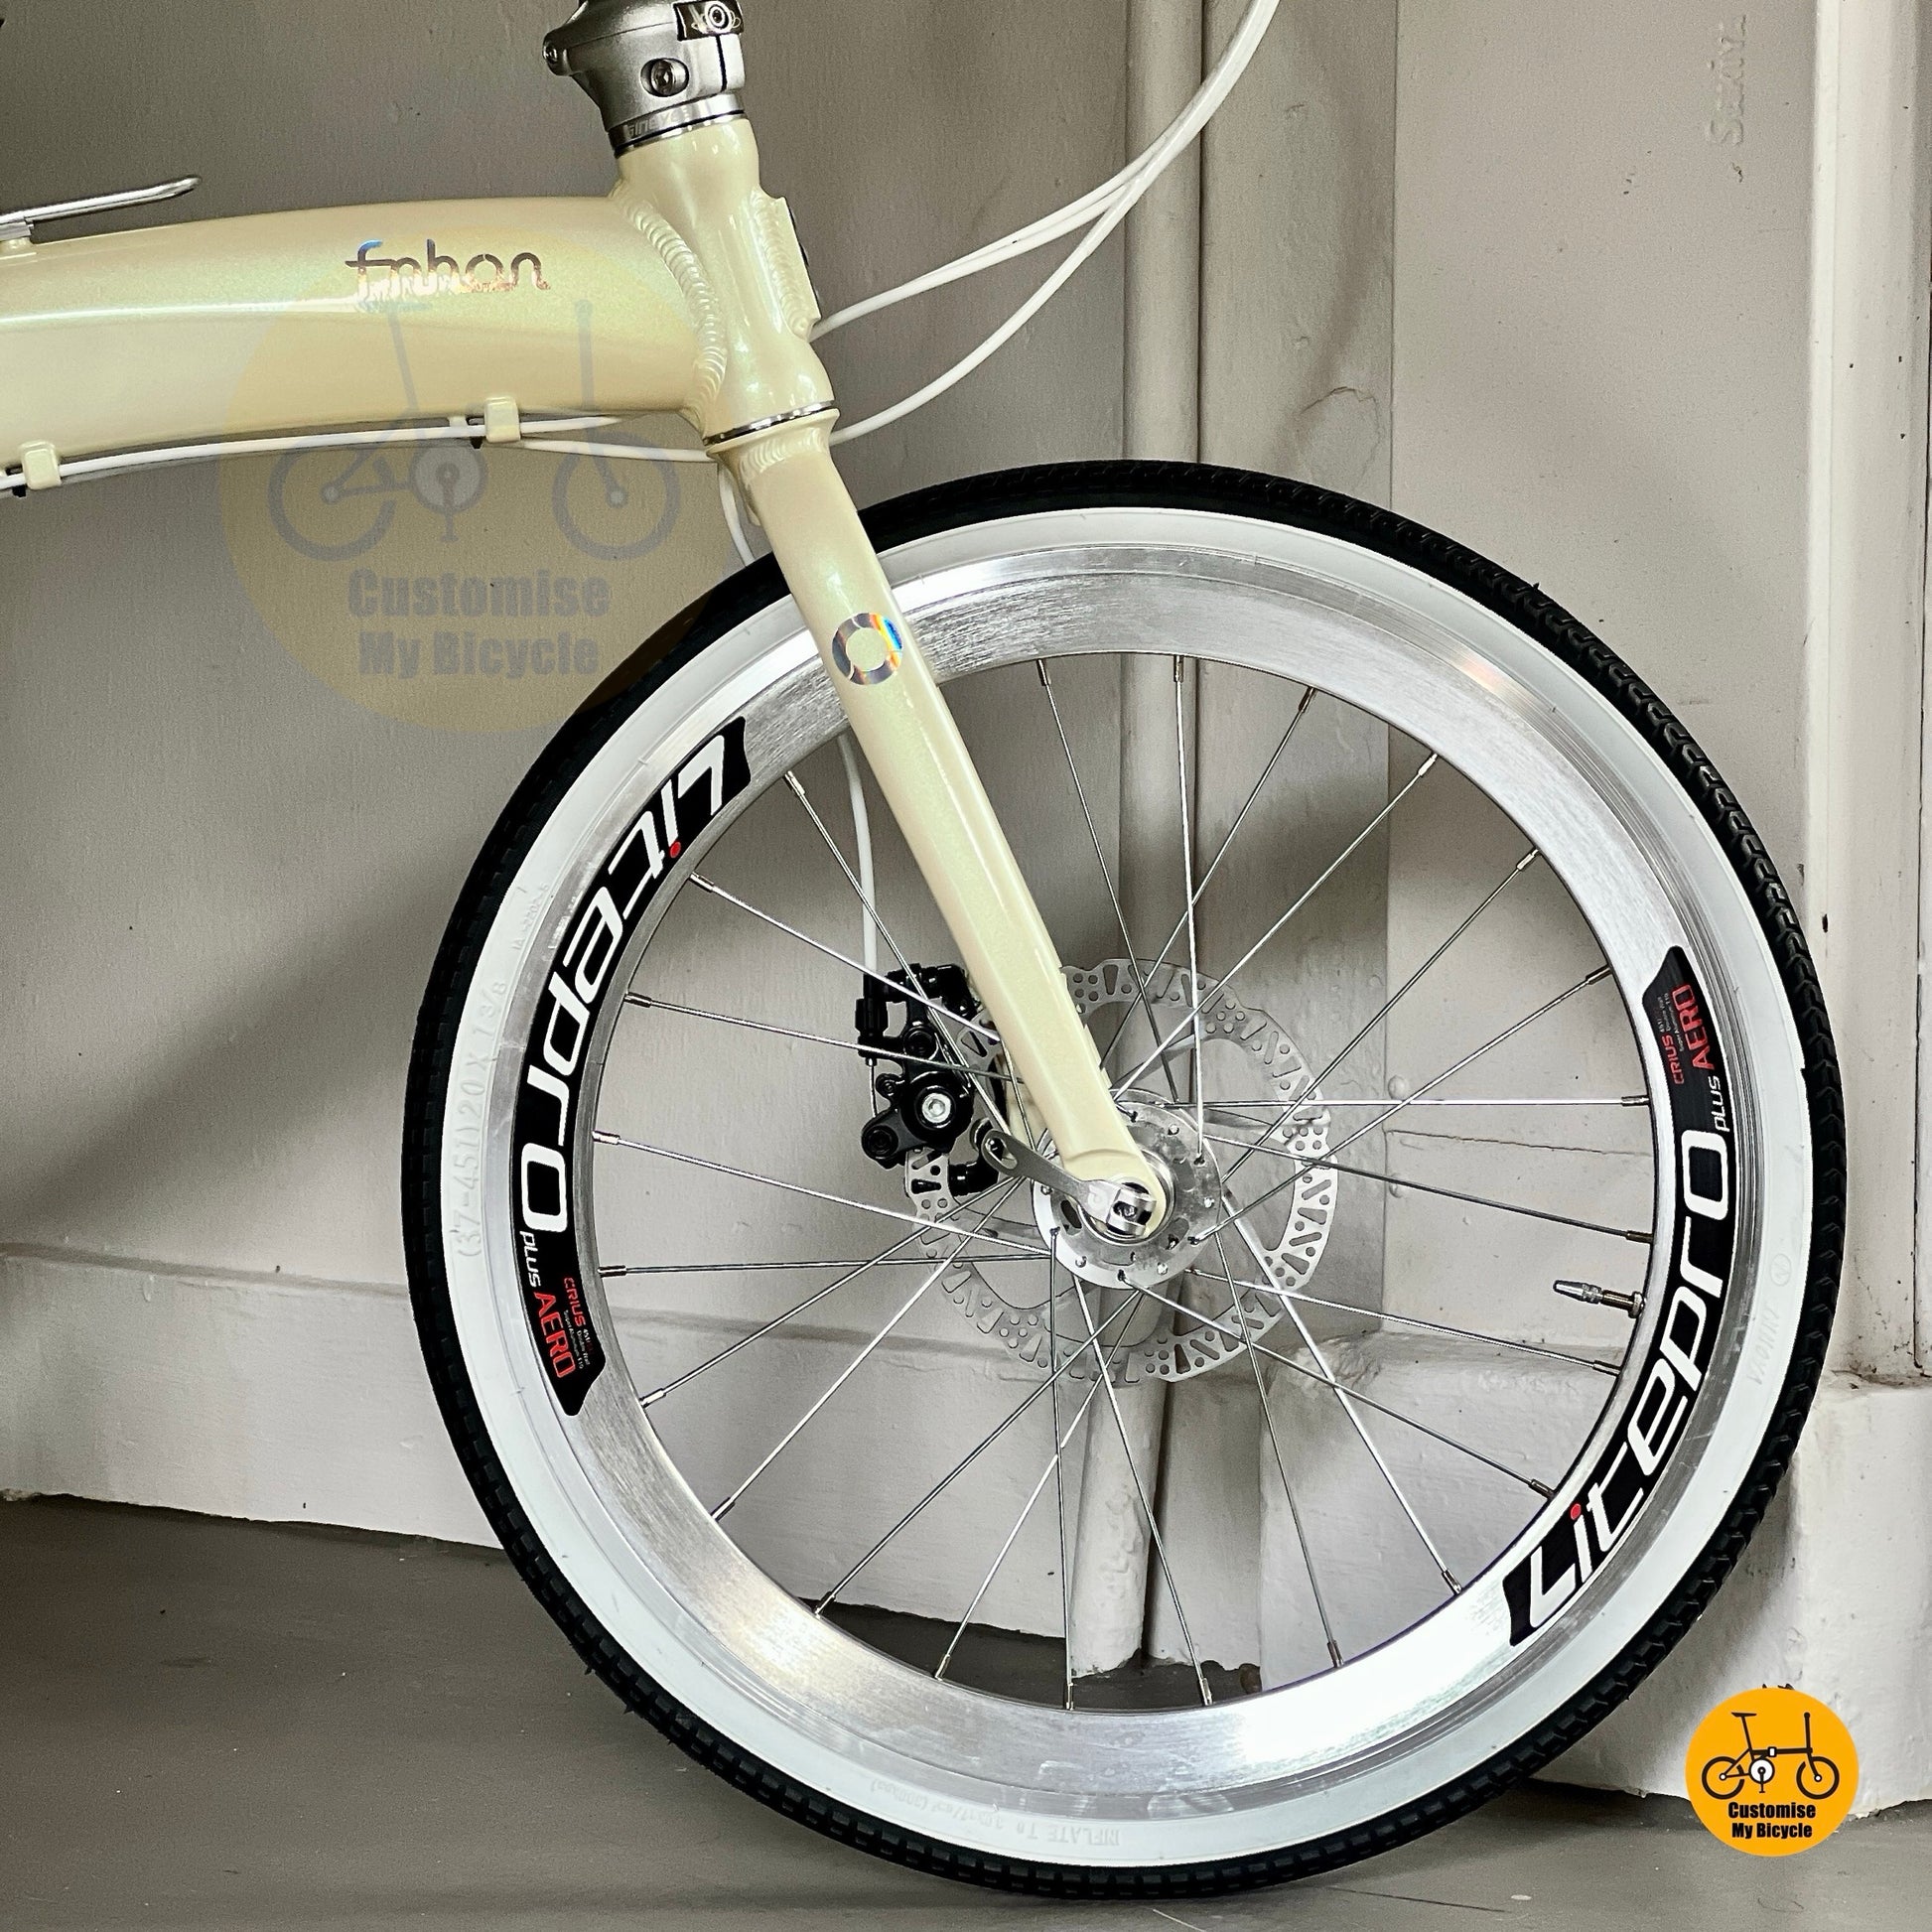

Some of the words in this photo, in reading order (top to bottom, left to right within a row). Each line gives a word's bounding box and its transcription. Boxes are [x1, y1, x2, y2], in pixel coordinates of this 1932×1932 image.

[521, 735, 725, 1232] Litepro
[1662, 1034, 1685, 1085] CRIUS
[534, 1292, 577, 1379] AERO
[564, 1277, 586, 1327] CRIUS
[1529, 1130, 1728, 1628] Litepro
[1671, 984, 1716, 1070] AERO
